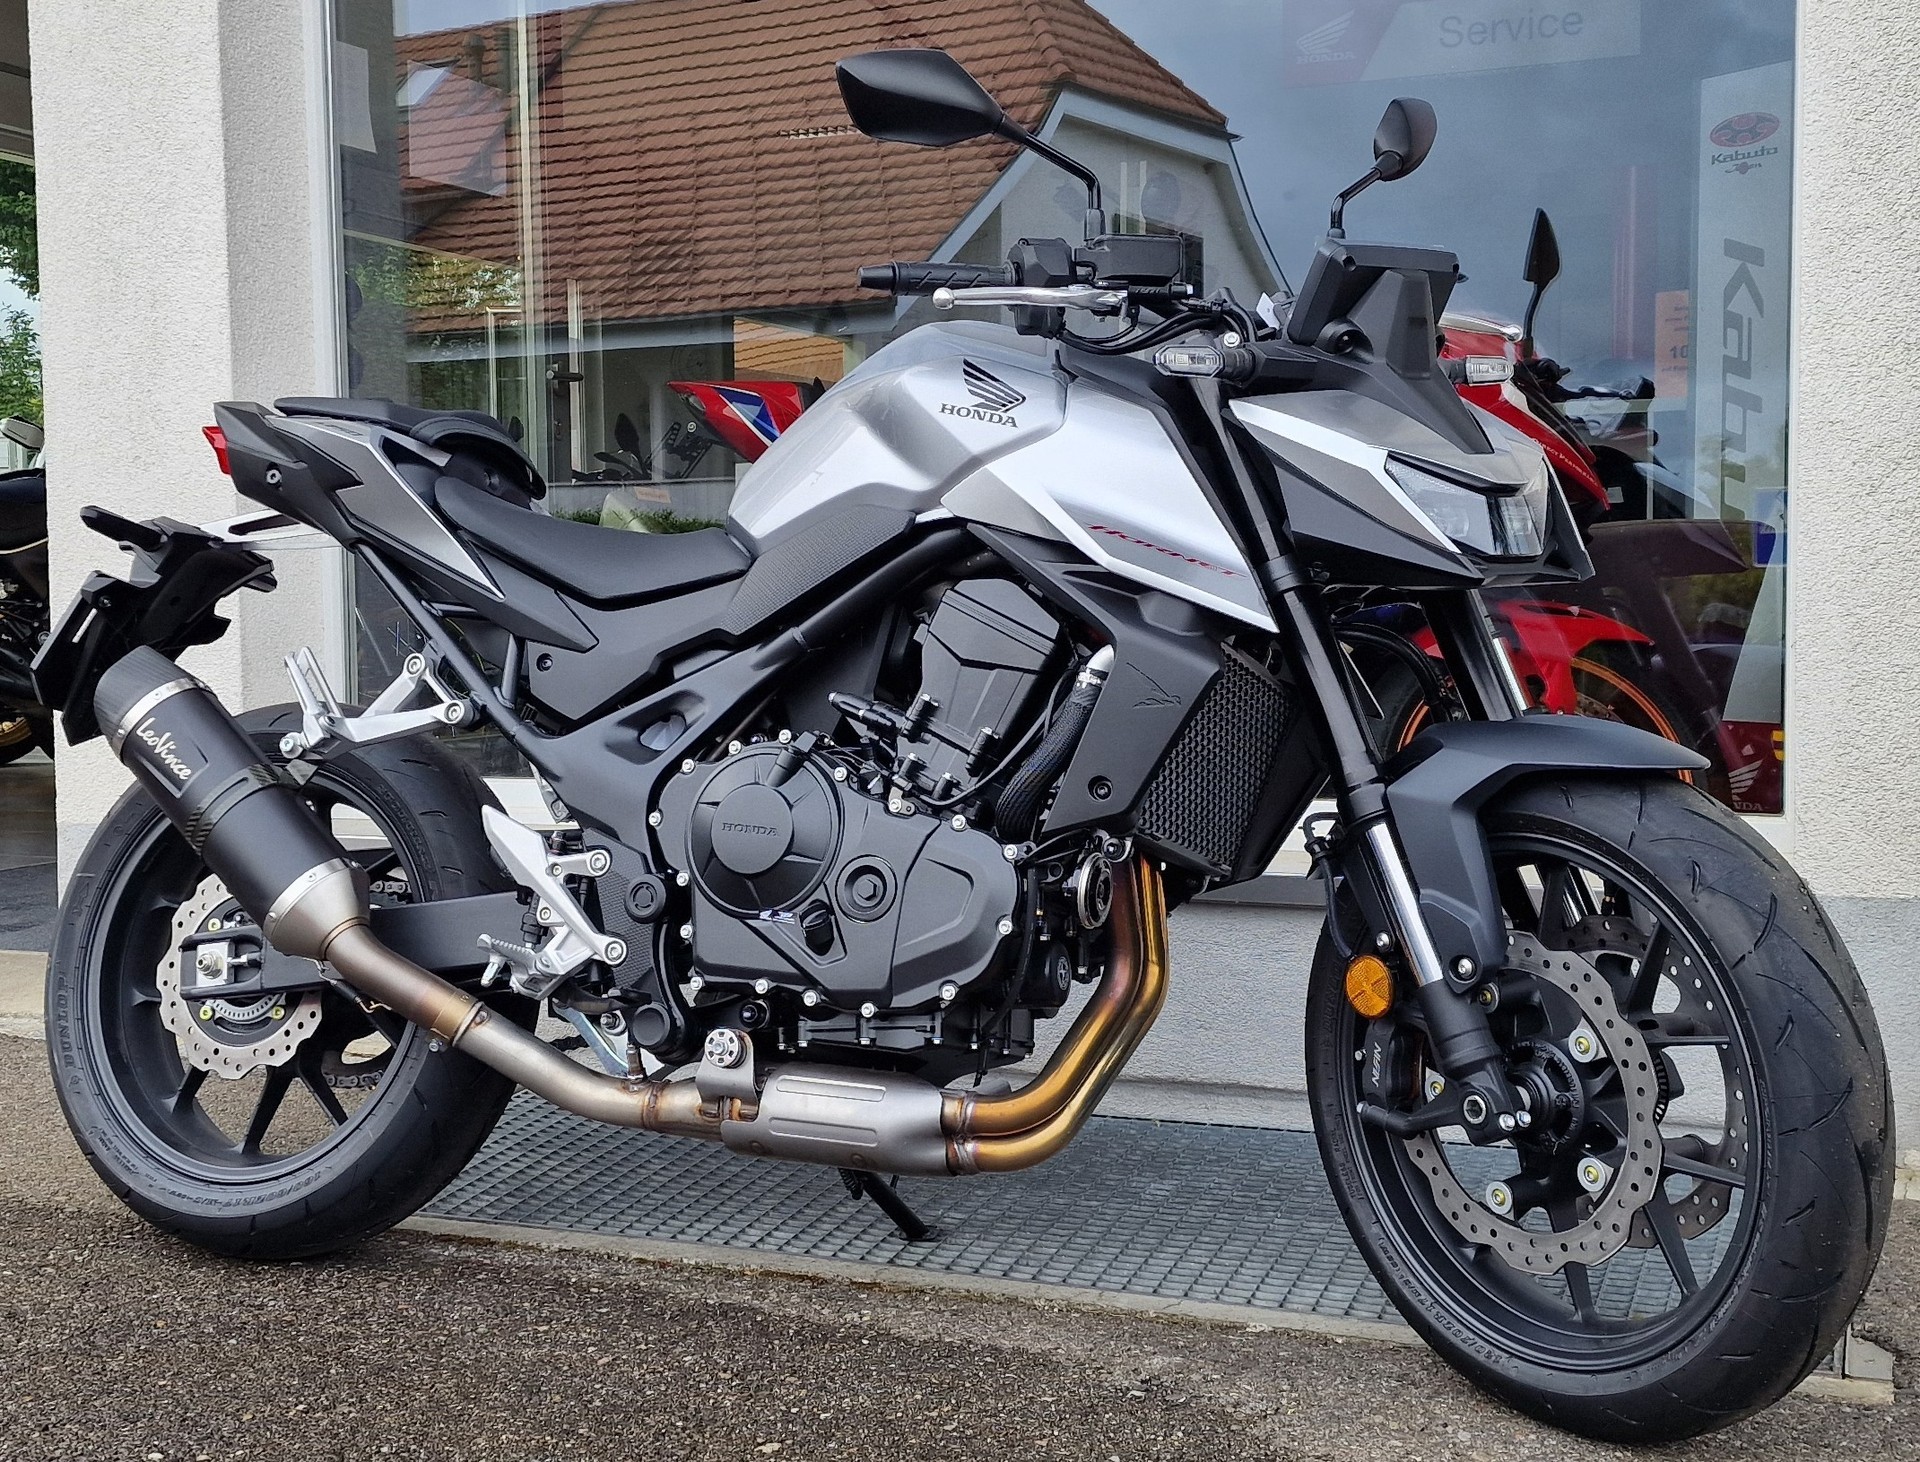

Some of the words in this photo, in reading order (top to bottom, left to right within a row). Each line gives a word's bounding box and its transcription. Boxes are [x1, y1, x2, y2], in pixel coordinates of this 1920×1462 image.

[1439, 9, 1584, 48] Service
[1296, 50, 1356, 65] HONDA
[1711, 146, 1778, 166] Kabuto
[938, 402, 1019, 429] HONDA
[135, 716, 192, 780] LeoVince
[721, 821, 779, 838] HONDA
[57, 971, 76, 1069] DUNLOP
[1371, 1041, 1382, 1088] NISSIN
